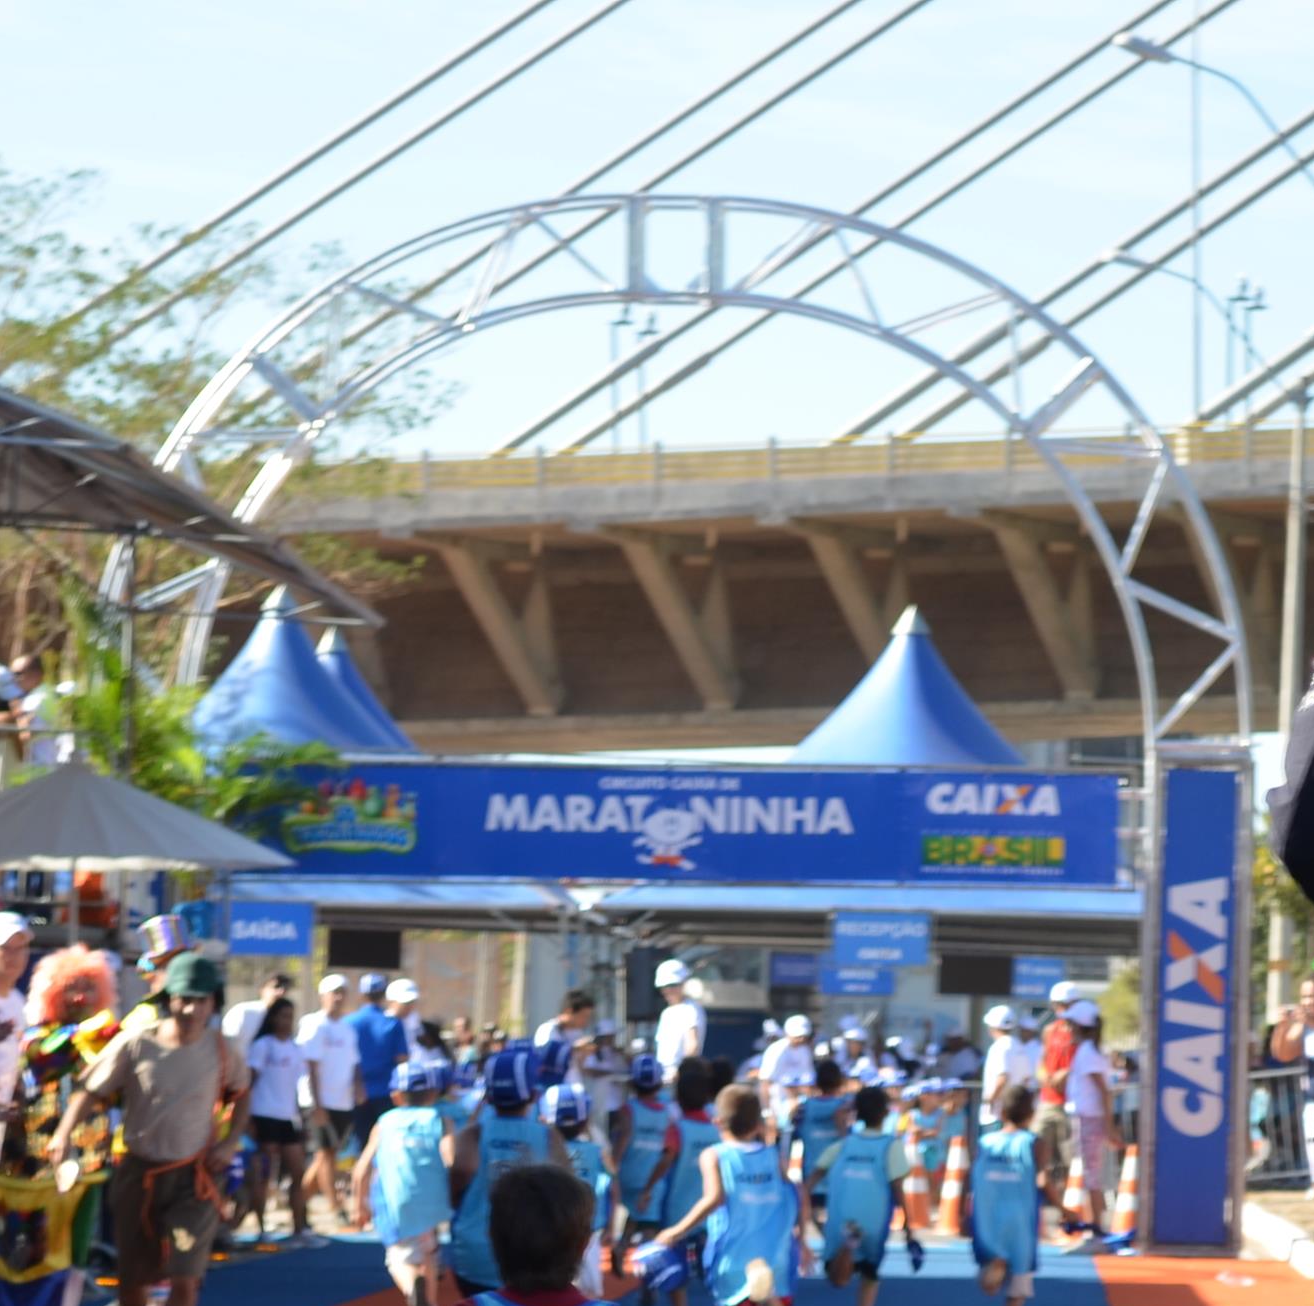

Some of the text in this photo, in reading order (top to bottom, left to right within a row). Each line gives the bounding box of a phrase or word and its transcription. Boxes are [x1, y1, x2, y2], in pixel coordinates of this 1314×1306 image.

[484, 793, 855, 836] MARATNINHA
[924, 782, 1061, 816] CAIXA
[922, 834, 1067, 866] BRASIL
[231, 917, 298, 940] SAÍDA
[1161, 876, 1229, 1137] CAIXA
